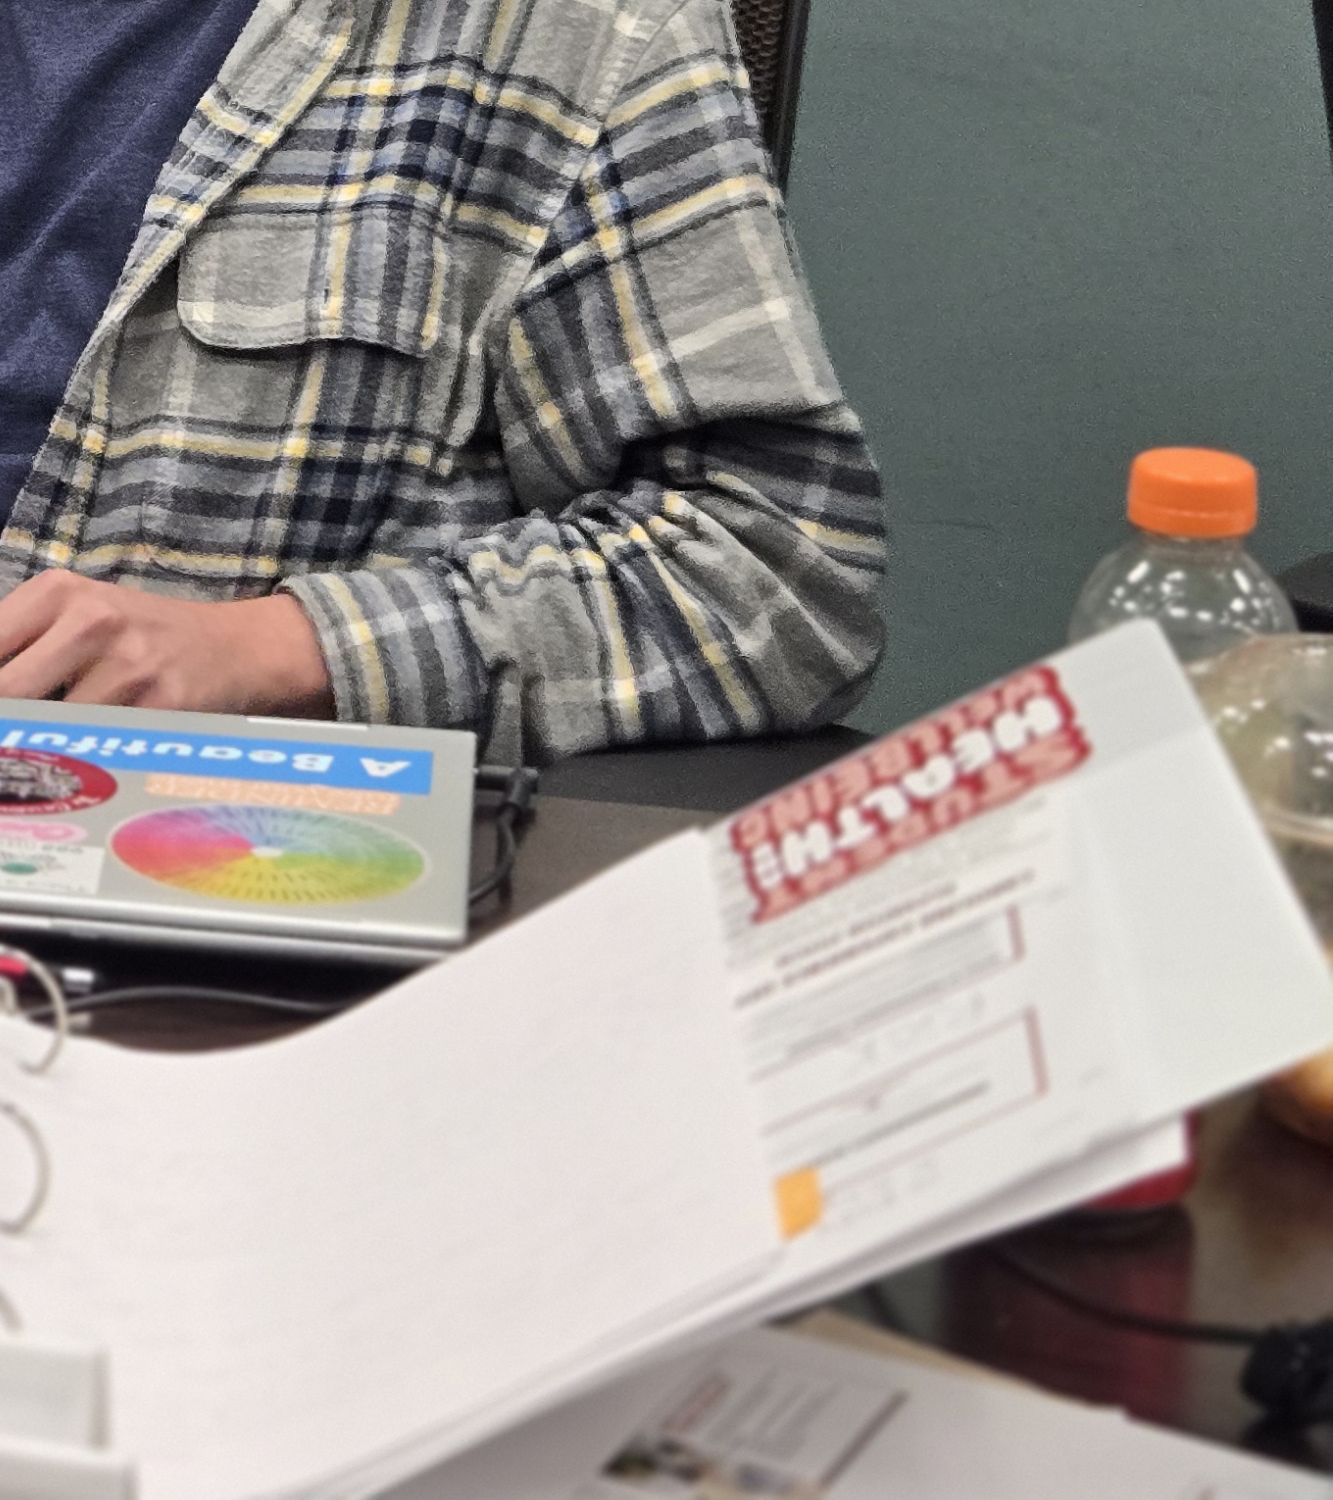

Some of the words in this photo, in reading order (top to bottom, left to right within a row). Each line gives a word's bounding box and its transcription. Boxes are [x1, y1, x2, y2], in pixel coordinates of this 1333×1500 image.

[0, 728, 334, 773] Beautiful
[359, 756, 413, 779] A
[781, 696, 1064, 878] HEALTH
